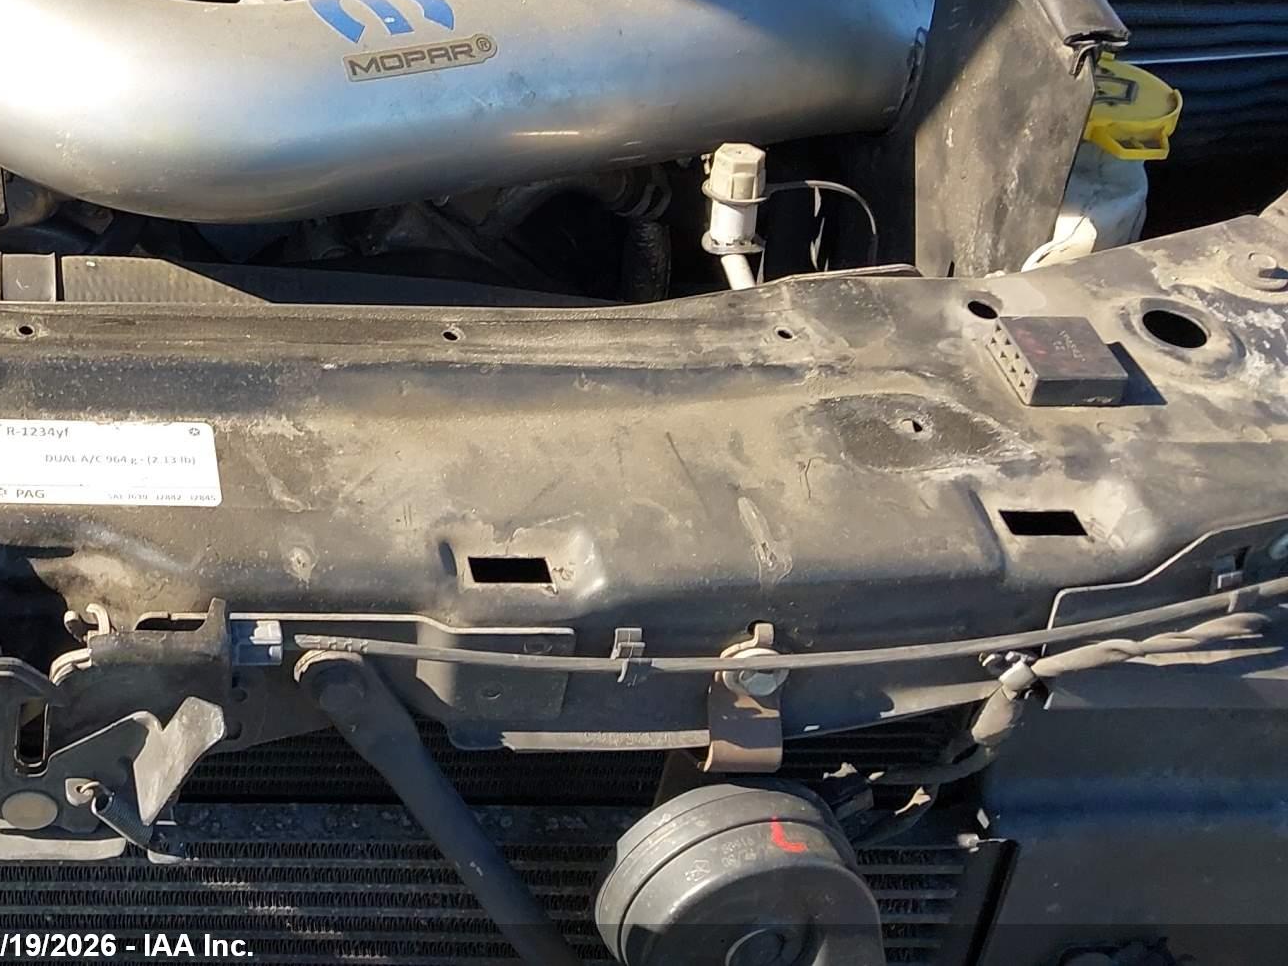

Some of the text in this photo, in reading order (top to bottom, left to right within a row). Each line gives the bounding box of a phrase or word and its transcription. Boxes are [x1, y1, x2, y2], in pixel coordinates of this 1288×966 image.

[6, 425, 69, 439] R-1234yf
[45, 453, 76, 464] DUAL
[81, 454, 102, 464] A/C
[15, 489, 46, 499] PAG
